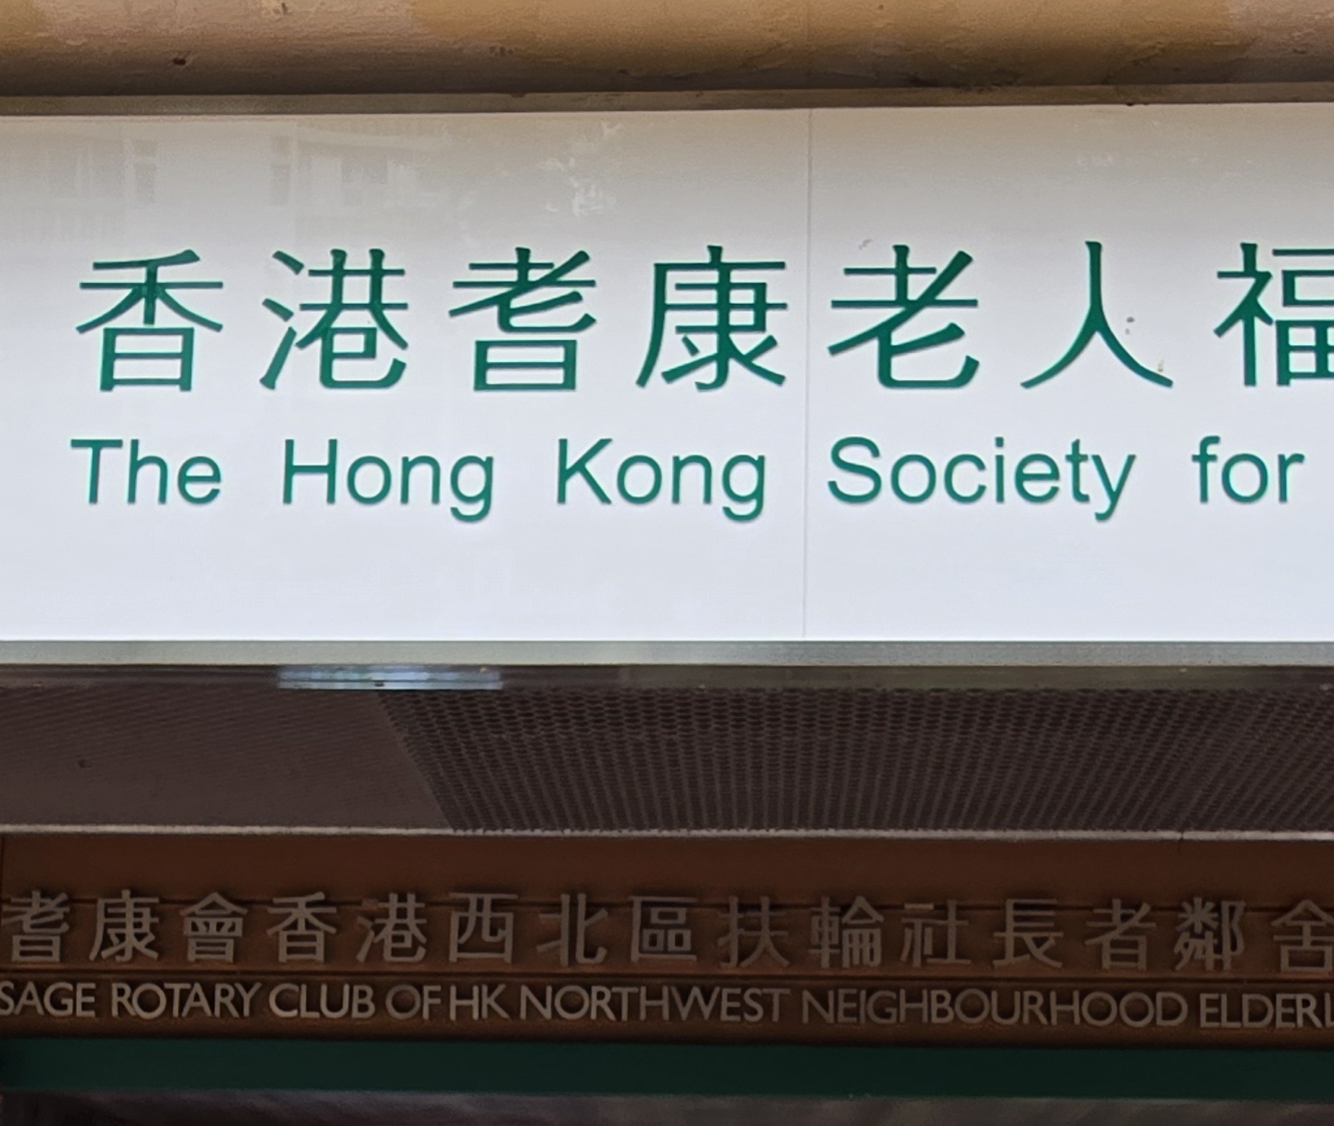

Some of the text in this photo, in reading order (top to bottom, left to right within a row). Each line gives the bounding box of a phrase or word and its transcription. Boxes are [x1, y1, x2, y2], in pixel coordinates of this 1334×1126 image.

[70, 439, 221, 503] The
[285, 440, 493, 521] Hong
[559, 439, 765, 520] Kong
[828, 437, 1132, 519] Society
[1195, 436, 1305, 502] for
[111, 981, 262, 1020] ROTARY
[269, 983, 376, 1020] CLUB
[386, 984, 443, 1021] OF
[449, 984, 510, 1021] HK
[802, 989, 1188, 1027] NEIGHBOURHOOD
